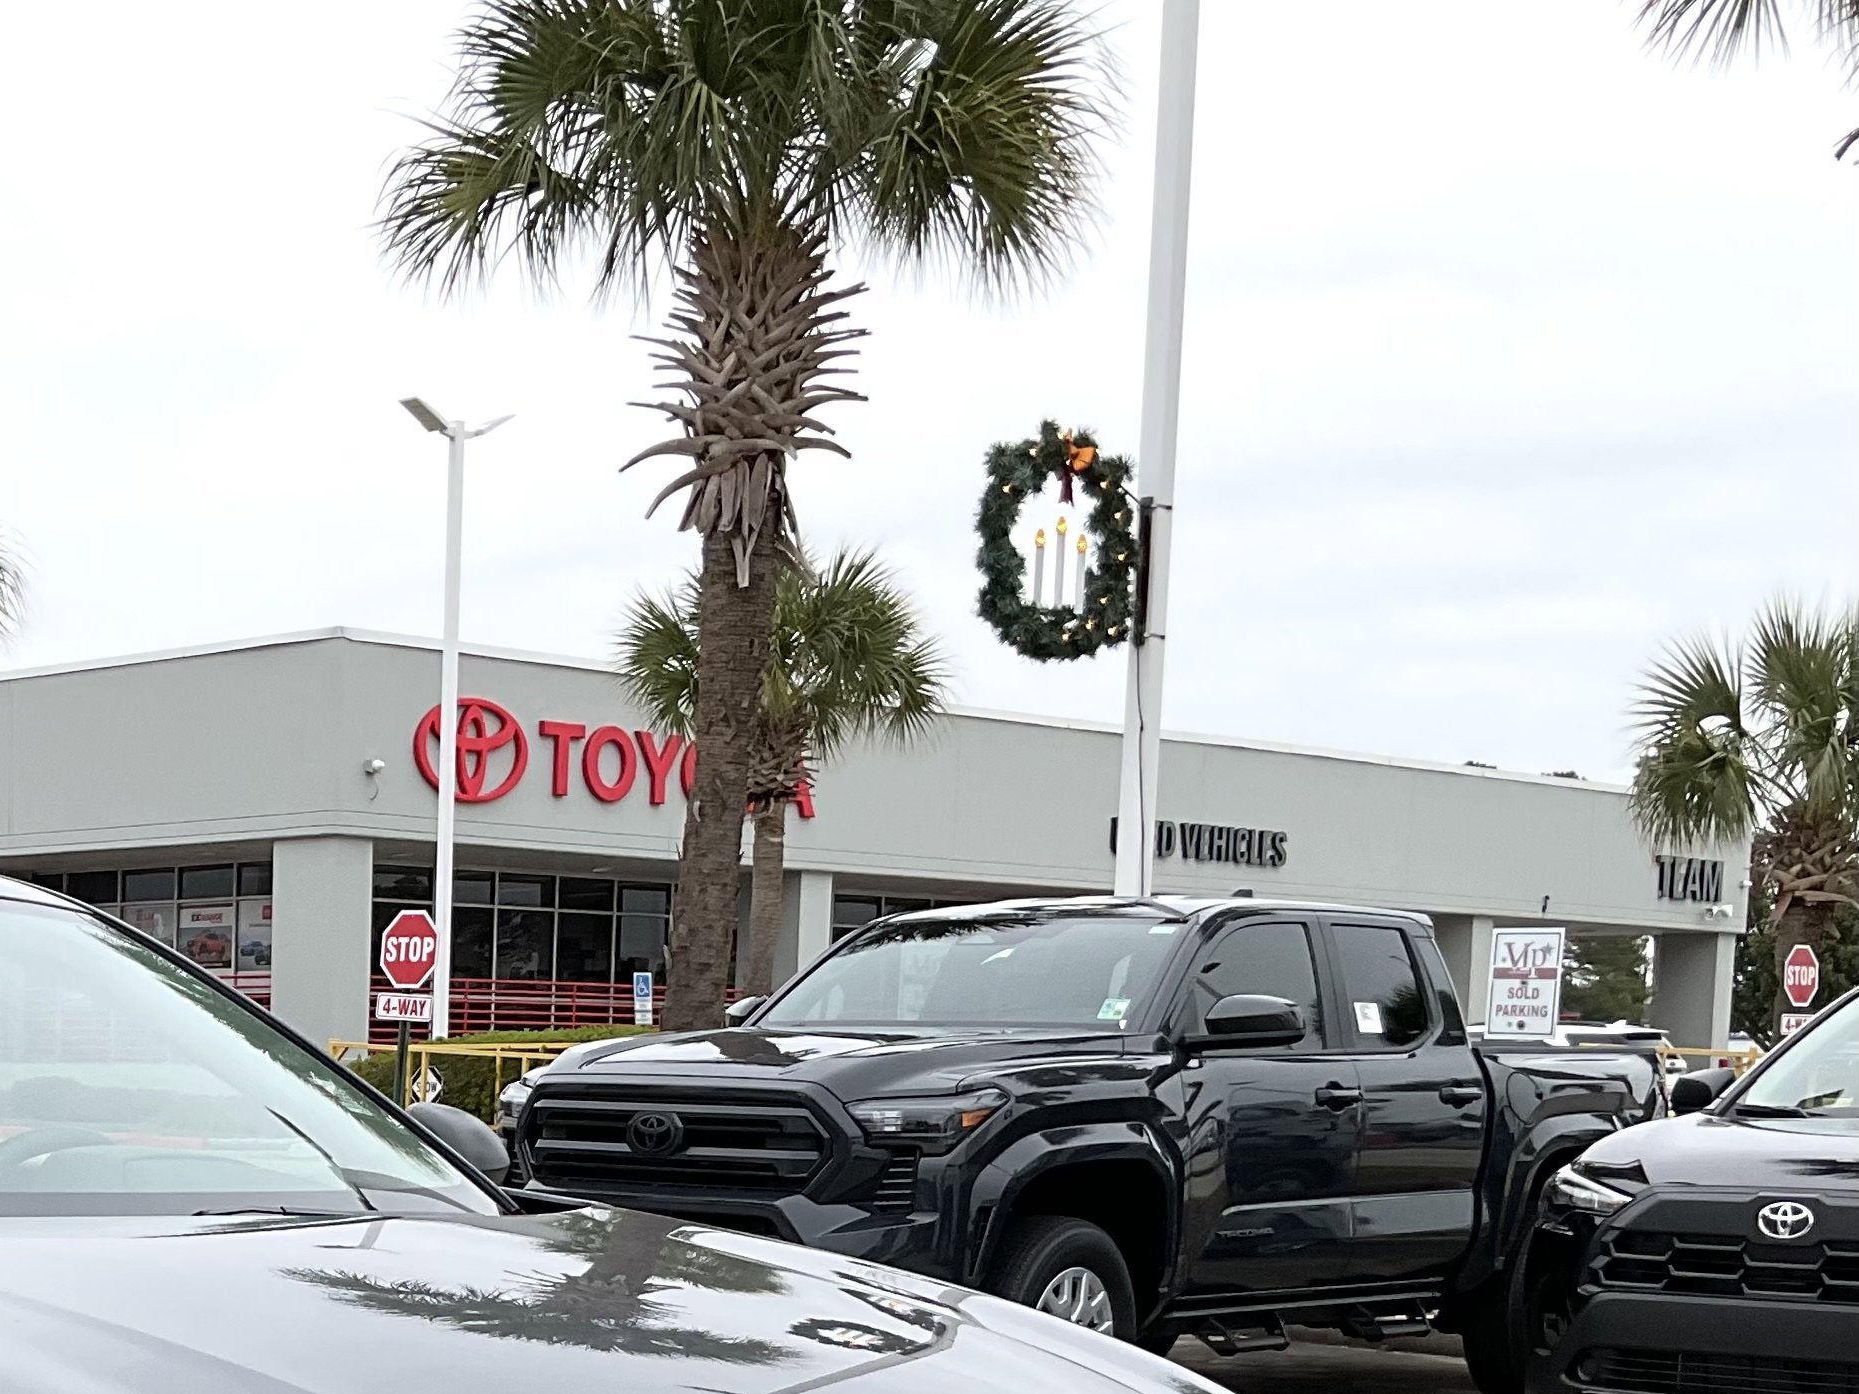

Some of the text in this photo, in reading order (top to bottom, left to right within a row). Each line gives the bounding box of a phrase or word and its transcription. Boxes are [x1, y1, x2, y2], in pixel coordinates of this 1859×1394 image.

[538, 720, 815, 818] TOY
[1180, 822, 1288, 867] VEHICLES
[1656, 855, 1724, 902] TEAM
[385, 936, 435, 963] STOP
[1787, 965, 1815, 986] STOP
[1507, 986, 1540, 1000] SOLD
[382, 997, 427, 1017] 4-WAY
[1495, 1004, 1548, 1018] PARKING
[416, 1081, 438, 1093] SOW
